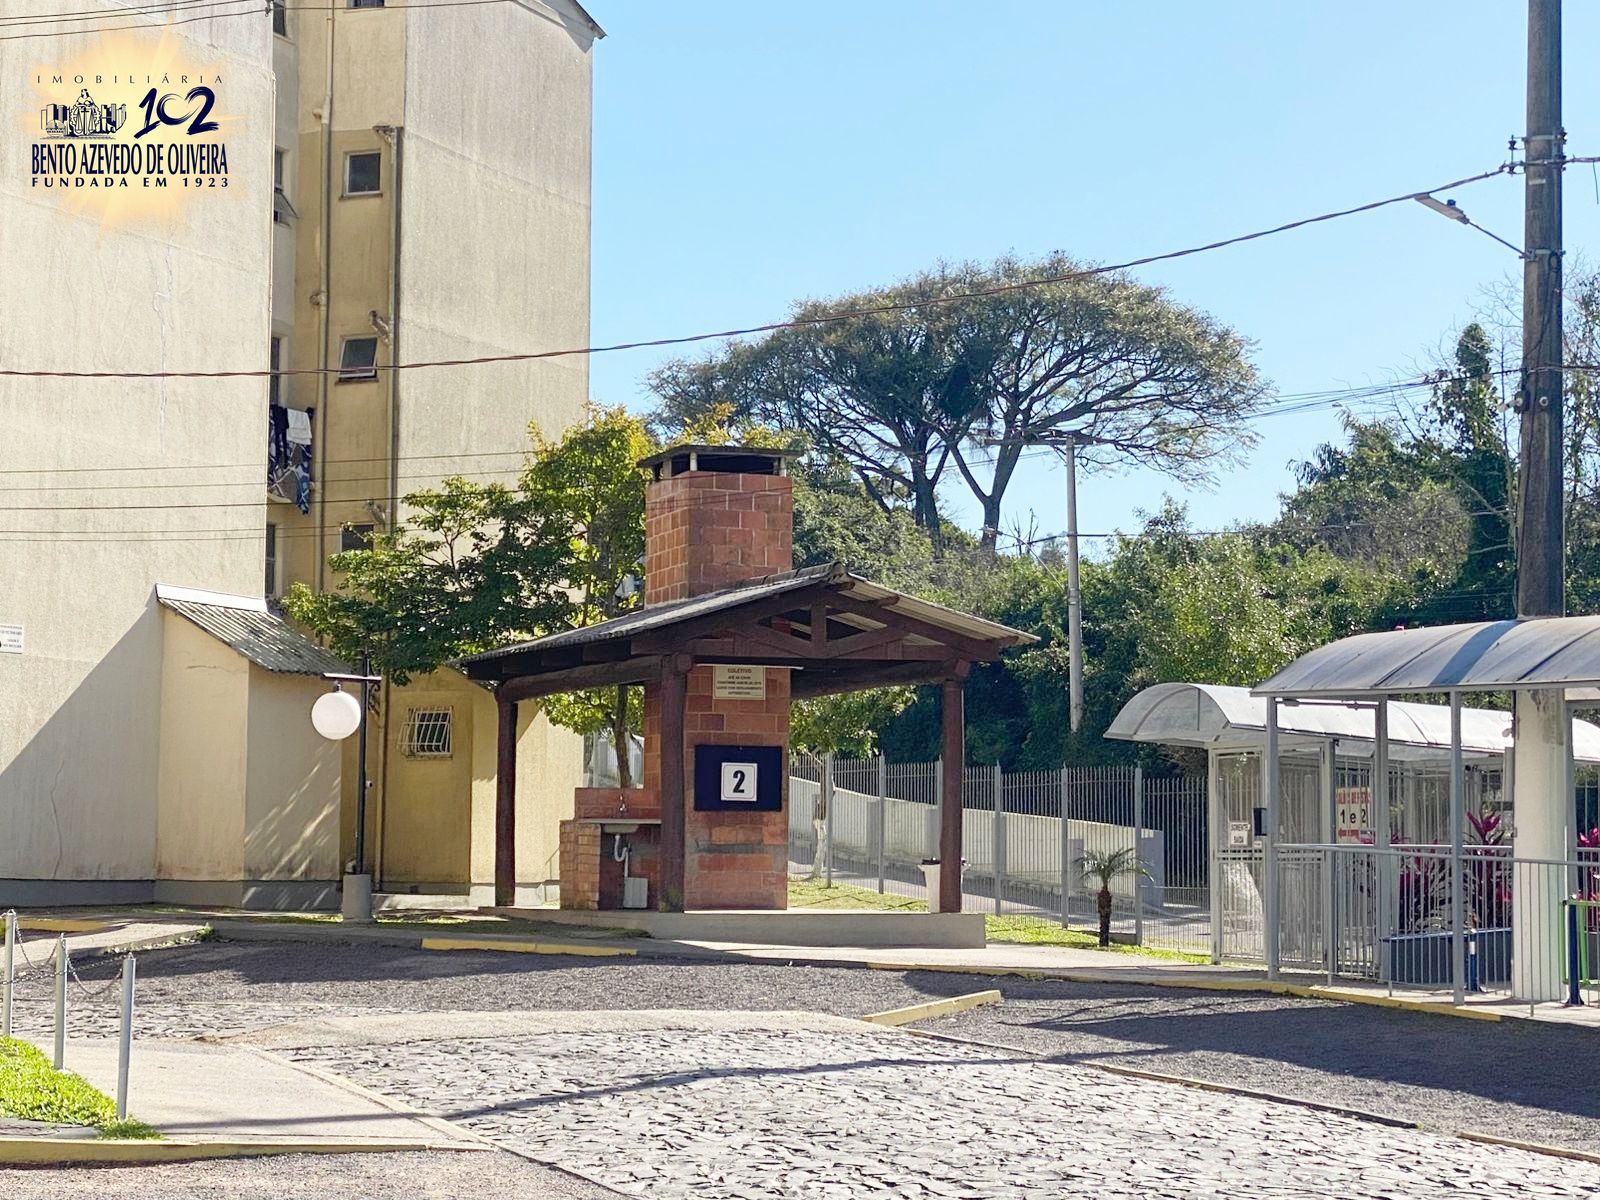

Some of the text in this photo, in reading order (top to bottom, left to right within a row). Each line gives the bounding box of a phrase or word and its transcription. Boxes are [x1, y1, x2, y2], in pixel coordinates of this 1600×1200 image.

[732, 770, 746, 794] 2
[1340, 809, 1367, 824] 1 e 2
